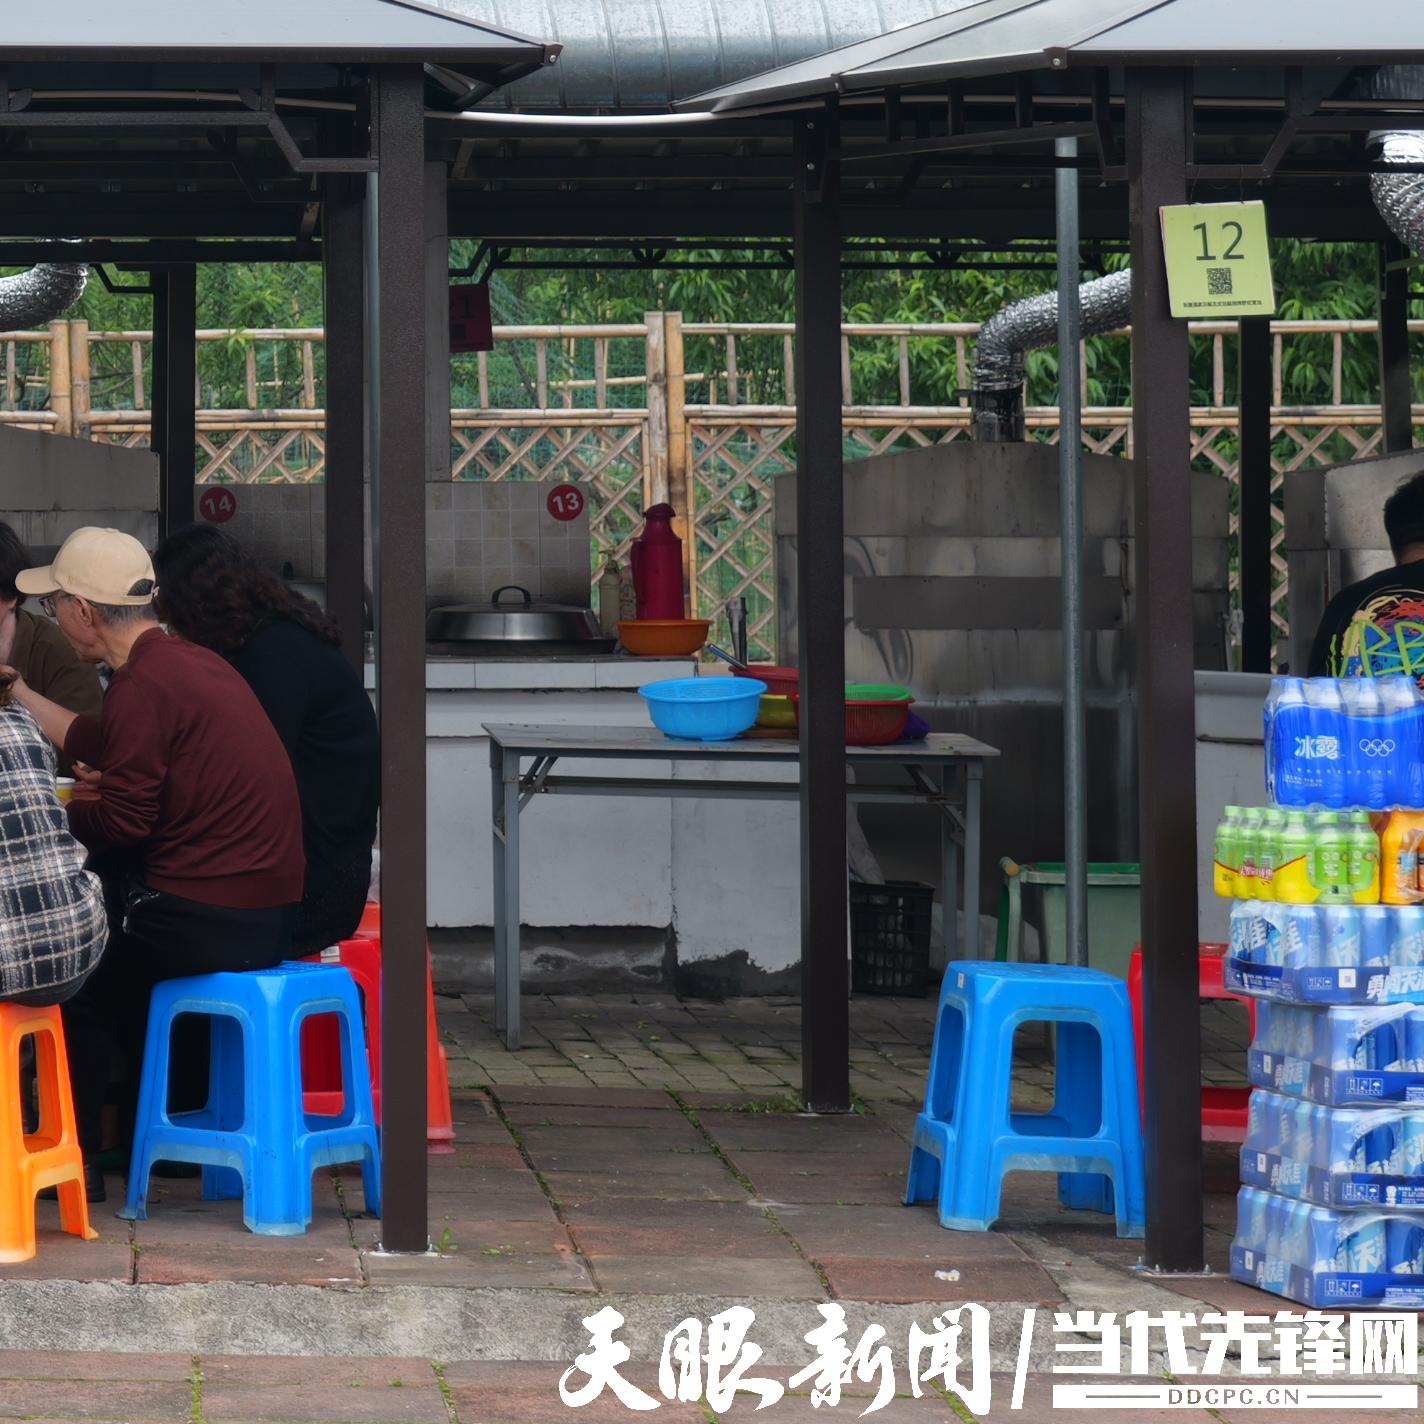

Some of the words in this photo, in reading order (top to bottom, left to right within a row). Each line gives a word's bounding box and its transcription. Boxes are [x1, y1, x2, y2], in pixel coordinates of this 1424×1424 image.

[1193, 220, 1245, 261] 12
[205, 494, 233, 516] 14
[552, 492, 580, 513] 13
[1294, 735, 1339, 760] 冰露
